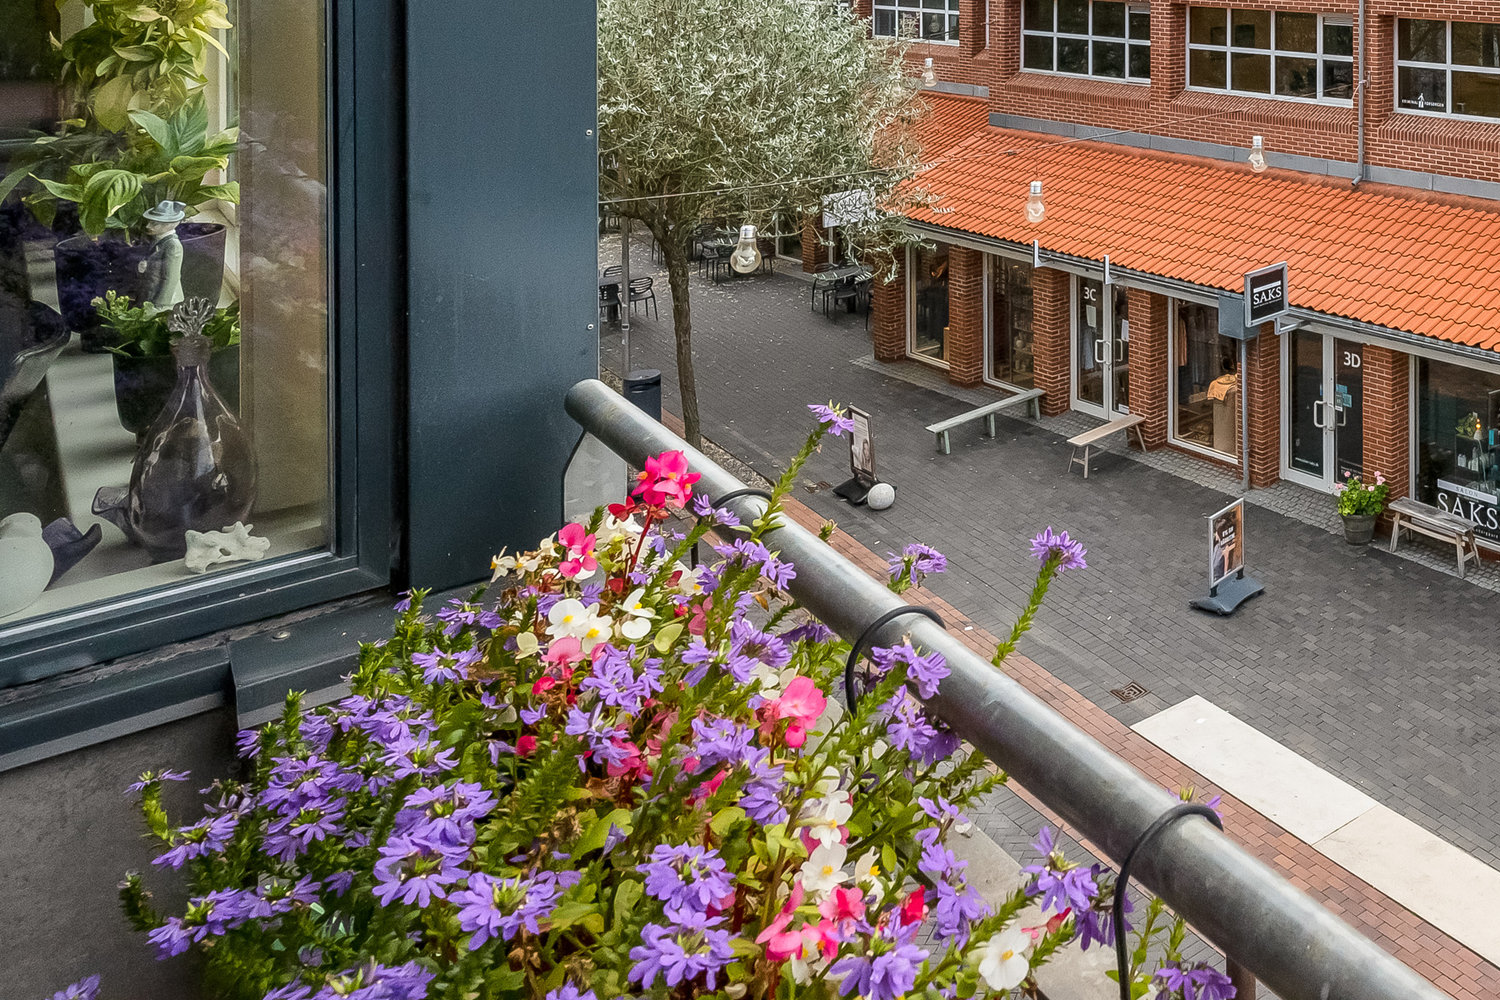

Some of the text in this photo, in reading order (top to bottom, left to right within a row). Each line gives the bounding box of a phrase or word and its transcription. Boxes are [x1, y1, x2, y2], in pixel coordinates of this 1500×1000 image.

[1083, 286, 1097, 302] 3C
[1343, 351, 1361, 368] 3D
[1455, 485, 1479, 498] SALON
